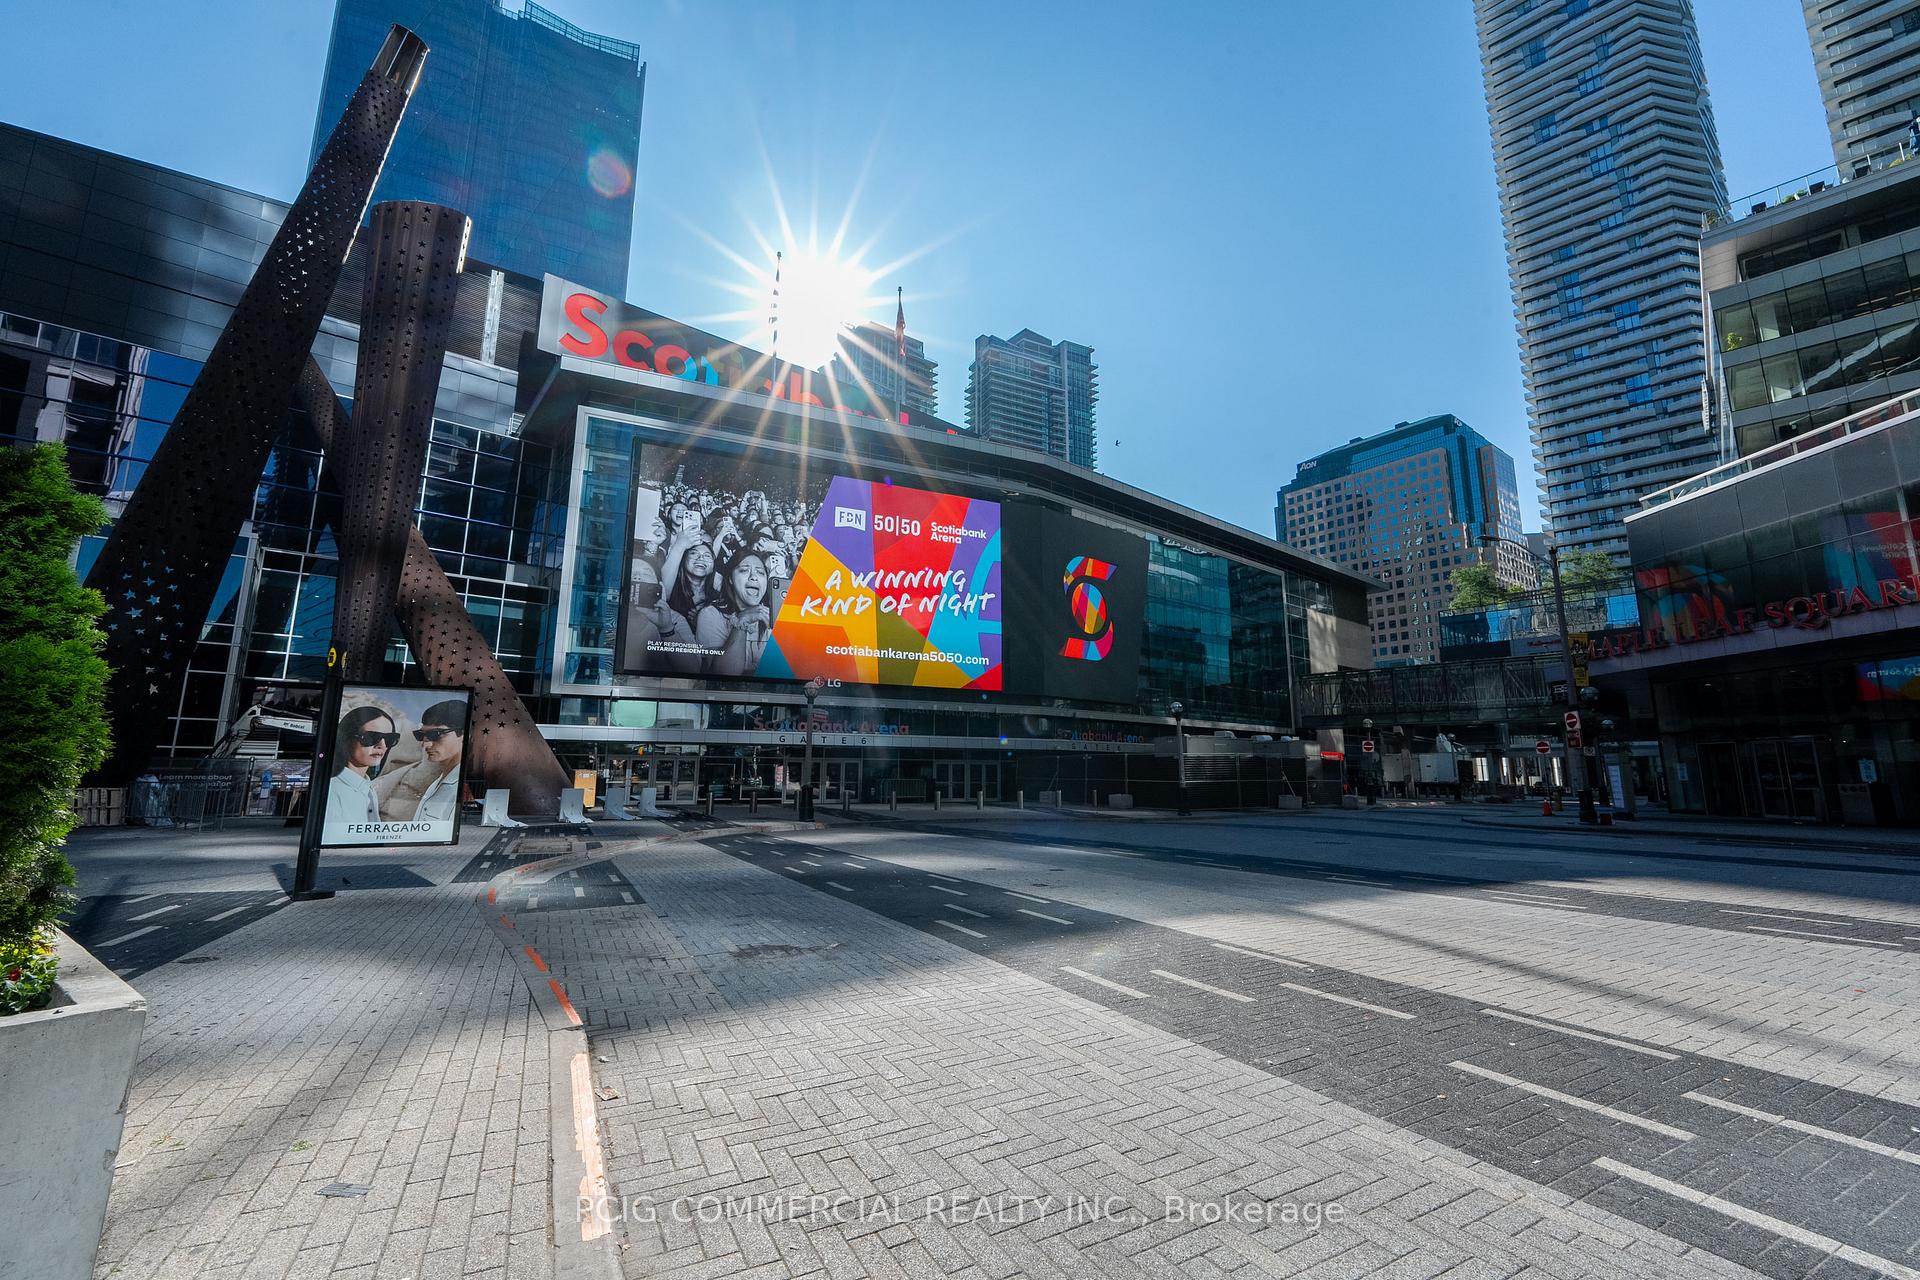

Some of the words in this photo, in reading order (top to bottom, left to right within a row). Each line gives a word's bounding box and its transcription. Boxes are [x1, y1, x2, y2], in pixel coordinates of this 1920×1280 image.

[930, 521, 987, 541] Scotiabank
[930, 531, 962, 545] Arena
[824, 569, 843, 591] A
[850, 566, 967, 592] WINNING
[799, 594, 873, 617] KIND
[879, 592, 914, 617] OF
[918, 591, 996, 617] NIGHT
[824, 644, 990, 666] scotiabankarena5050.com
[826, 677, 842, 688] LG
[347, 822, 432, 834] FERRAGAMO
